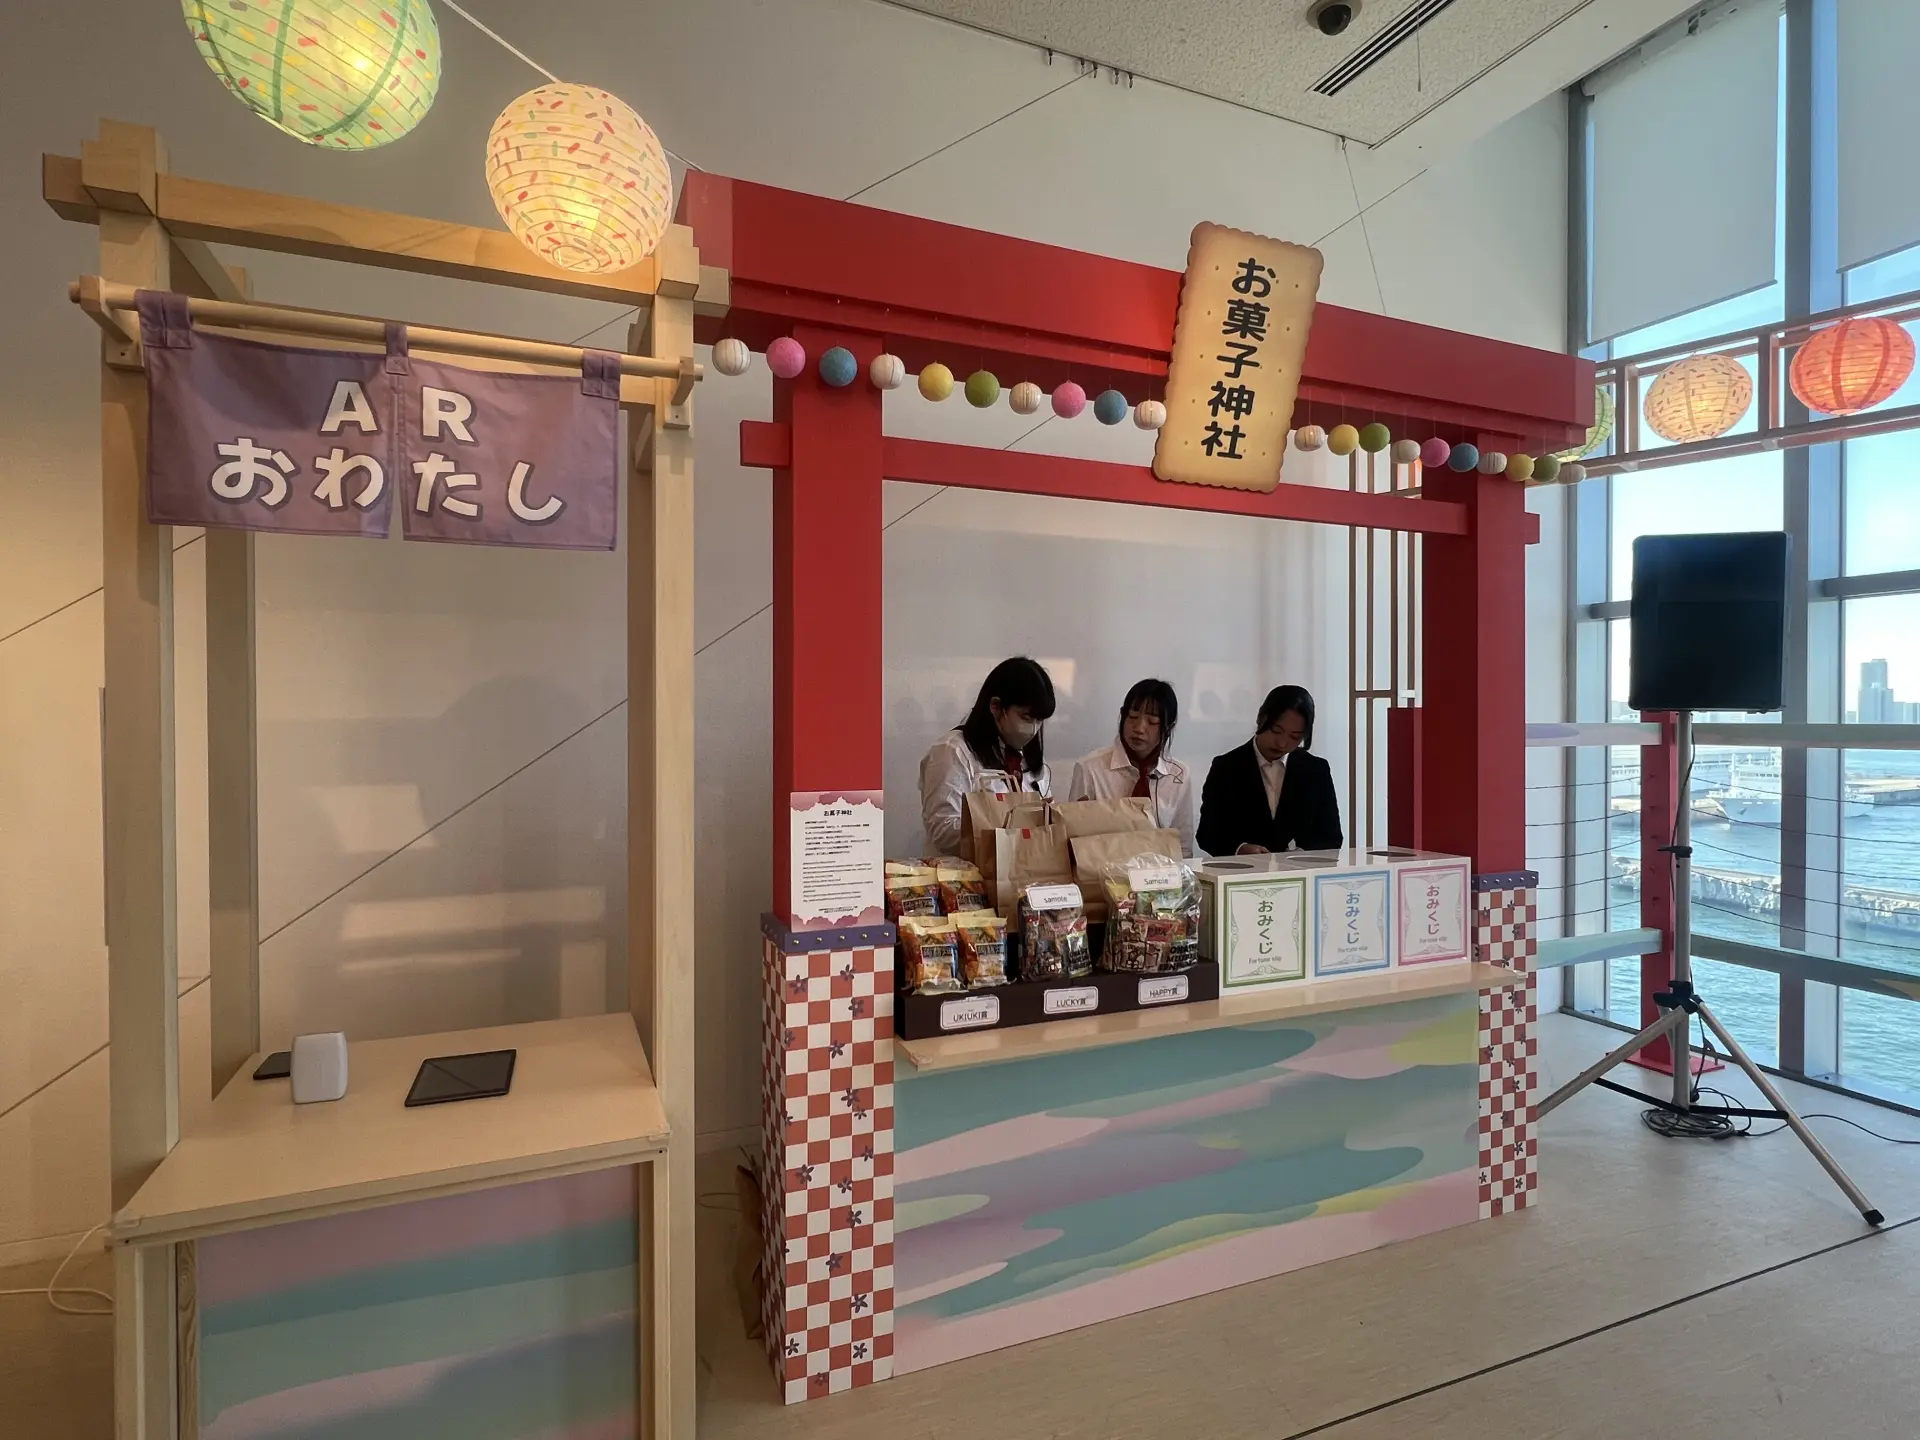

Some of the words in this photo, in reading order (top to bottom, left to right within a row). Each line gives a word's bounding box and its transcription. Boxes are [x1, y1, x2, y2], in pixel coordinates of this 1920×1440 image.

[1201, 258, 1277, 460] お菓子神社
[210, 436, 564, 523] おわたし
[1257, 900, 1274, 954] おみくじ
[1345, 892, 1361, 944] おみくじ
[1425, 884, 1440, 935] おみくじ
